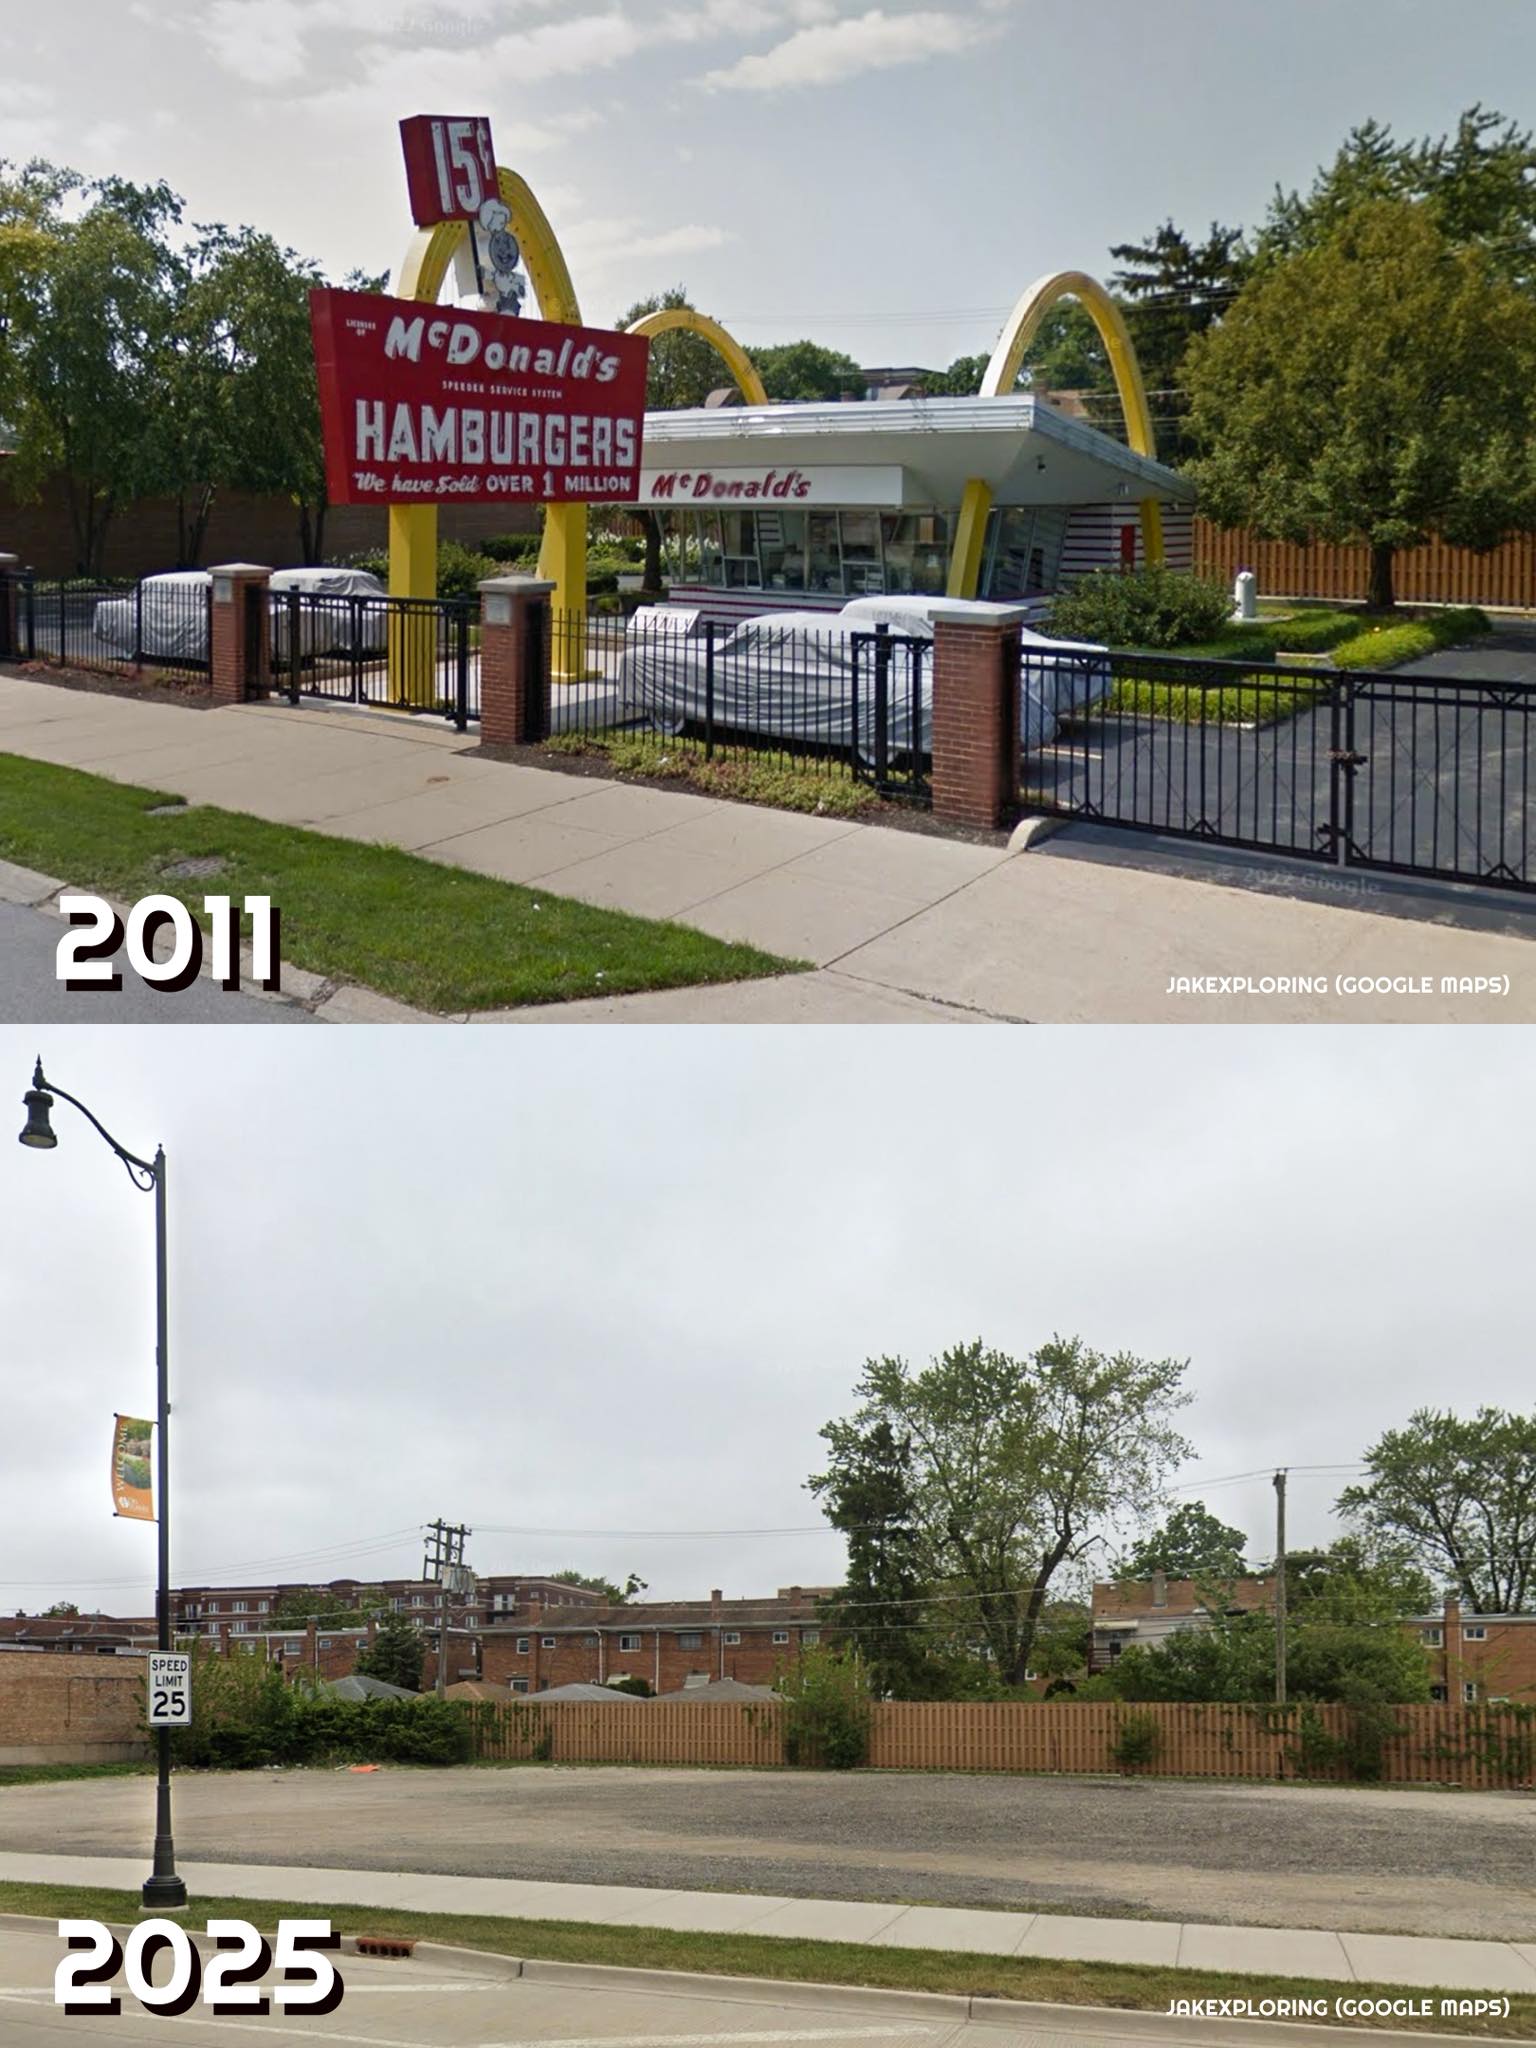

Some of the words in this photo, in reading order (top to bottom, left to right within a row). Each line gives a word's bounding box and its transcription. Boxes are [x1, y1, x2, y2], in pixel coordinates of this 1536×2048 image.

[384, 316, 621, 383] McDonald's
[355, 399, 637, 468] HAMBURGERS
[353, 471, 387, 493] We
[391, 472, 434, 493] have
[435, 475, 480, 494] Sold
[486, 475, 535, 493] OVER
[542, 471, 555, 497] 1
[564, 476, 631, 492] MILLION
[651, 471, 812, 498] McDonald's
[152, 1659, 188, 1672] SPEED
[155, 1675, 183, 1687] LIMIT
[153, 1690, 185, 1717] 25
